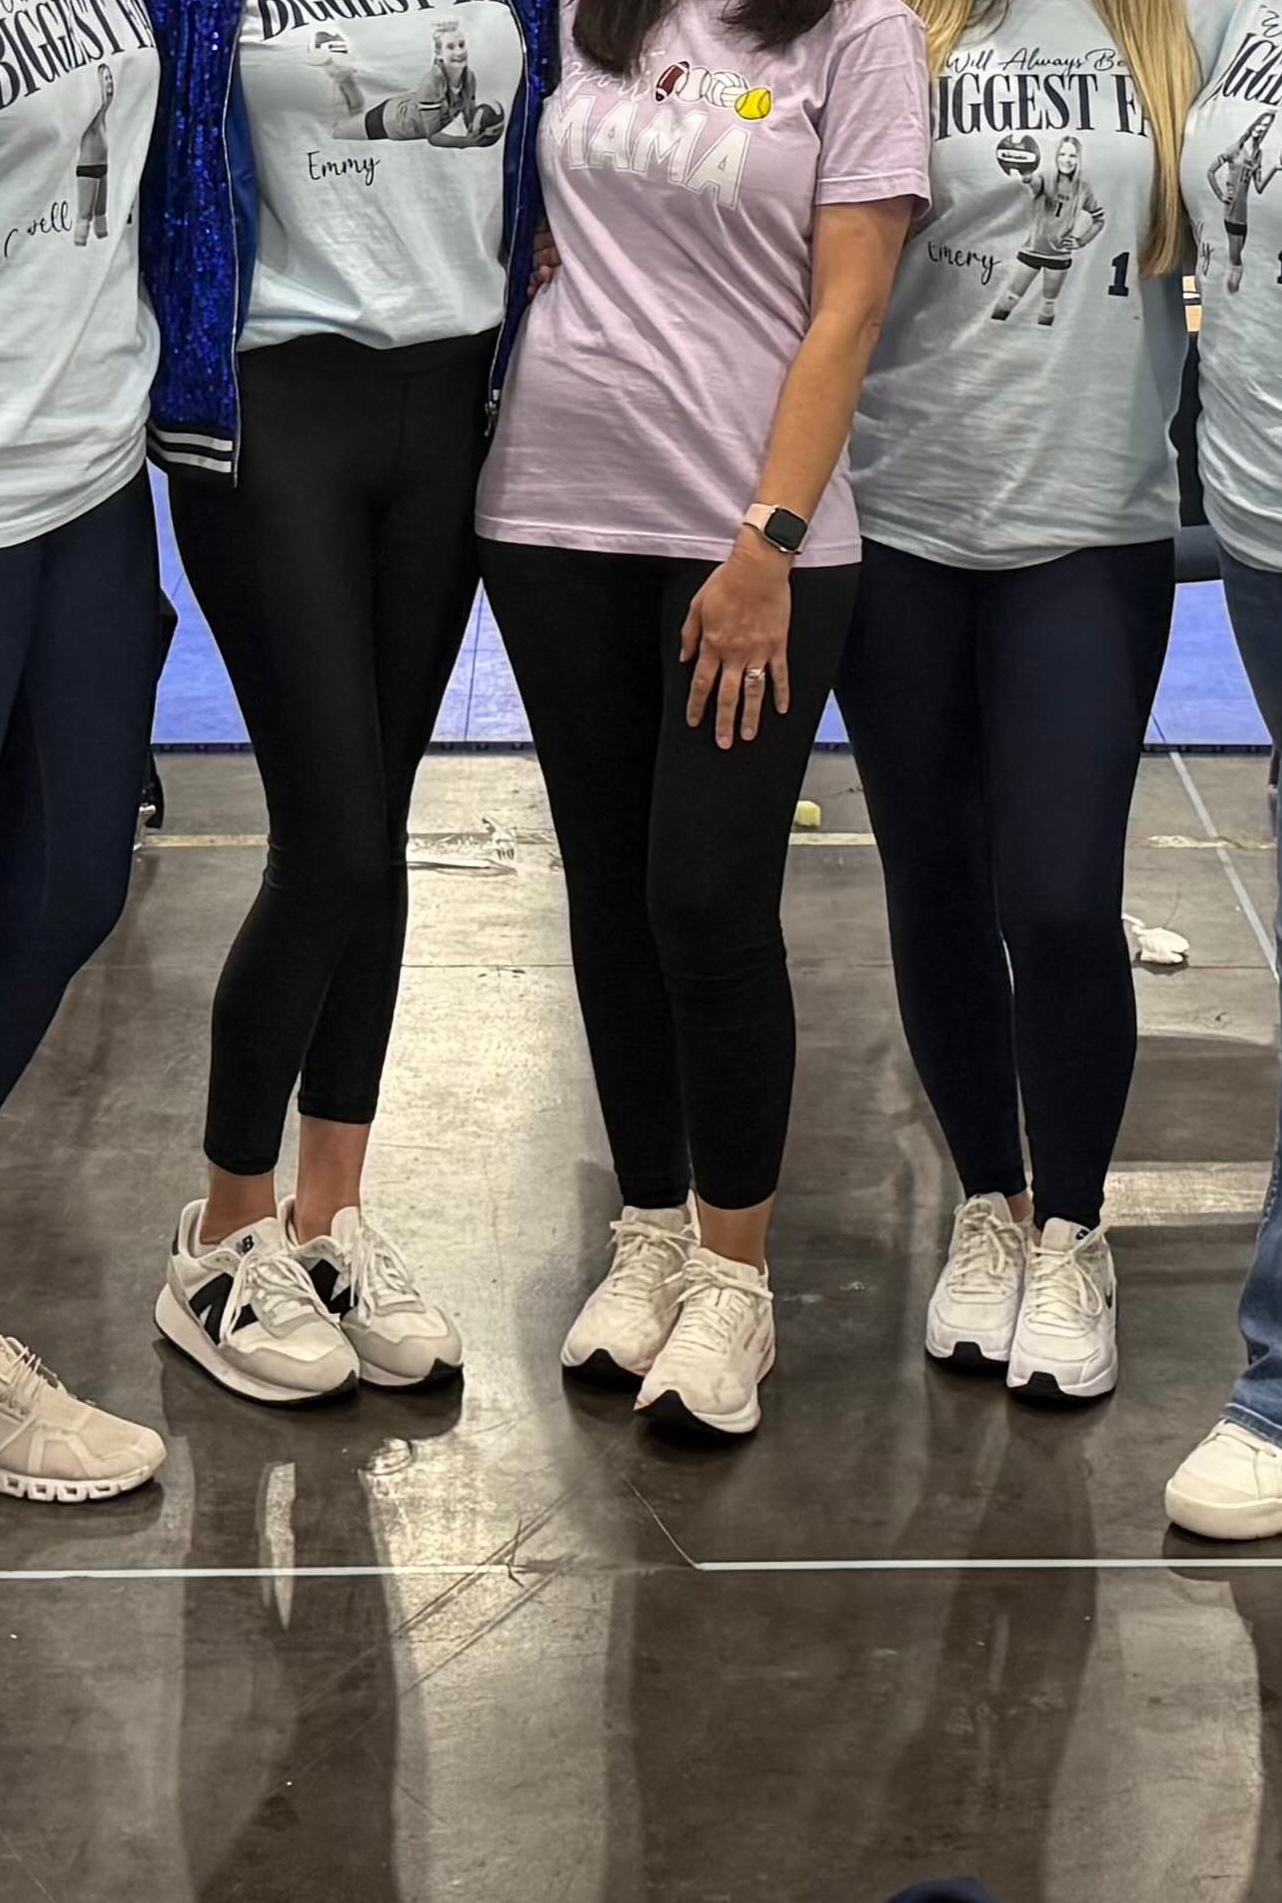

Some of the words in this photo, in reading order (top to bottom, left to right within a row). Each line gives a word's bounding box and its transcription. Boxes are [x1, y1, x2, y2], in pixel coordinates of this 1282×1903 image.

[945, 49, 992, 72] Will
[998, 47, 1083, 76] Always
[935, 72, 1099, 142] IGGEST
[307, 150, 380, 186] Emmy
[546, 94, 751, 211] MAMA
[1108, 251, 1130, 297] 1
